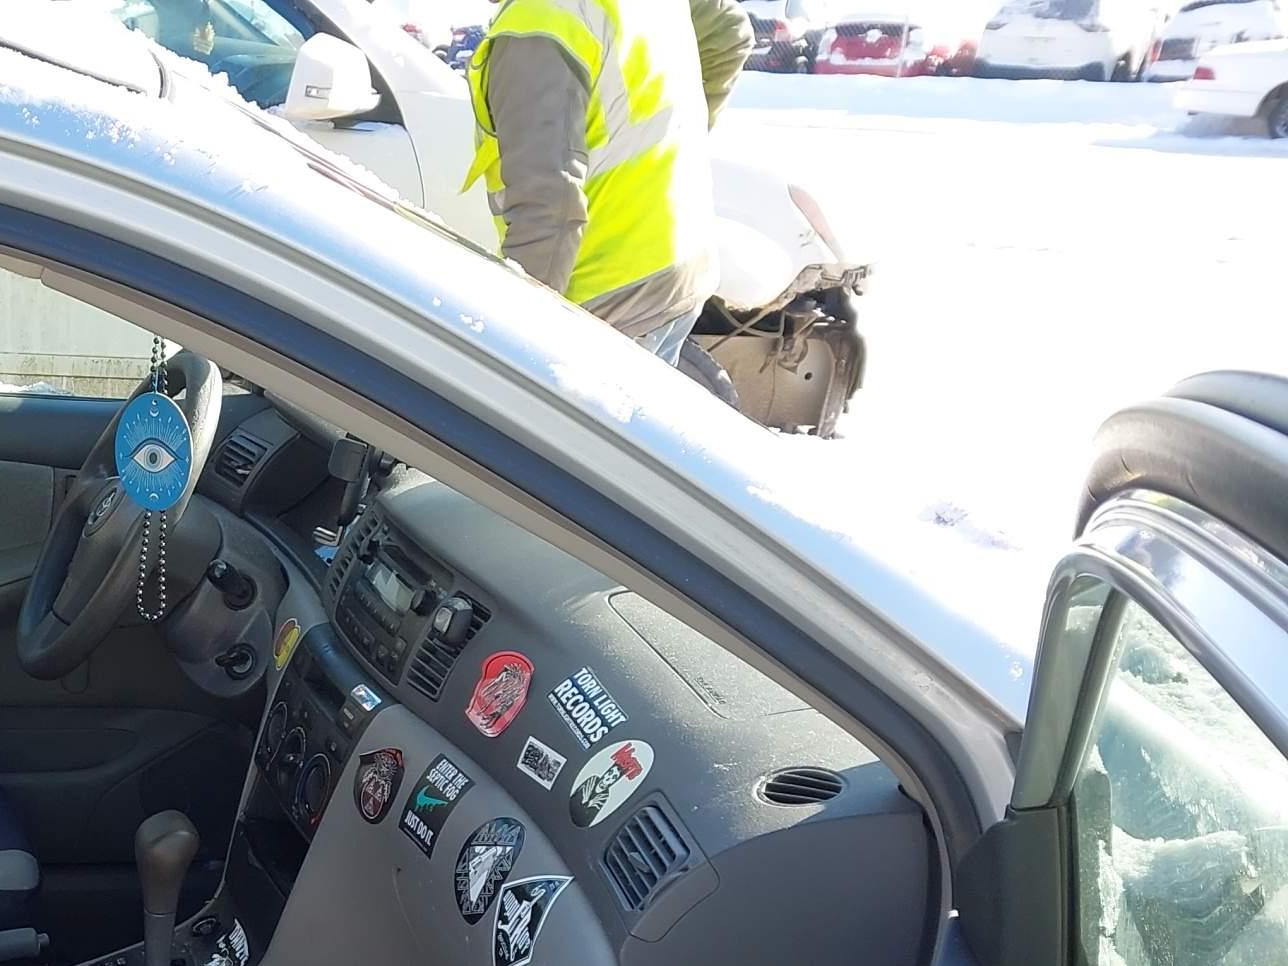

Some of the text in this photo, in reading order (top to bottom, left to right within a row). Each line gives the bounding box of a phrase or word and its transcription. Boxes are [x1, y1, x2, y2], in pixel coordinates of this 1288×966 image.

[554, 679, 609, 742] RECORDS
[573, 667, 626, 727] TORN LIGHT
[426, 768, 459, 801] SEPTIC FOG
[436, 758, 469, 789] ENTER THE
[404, 809, 421, 831] JUST
[417, 821, 428, 839] DO
